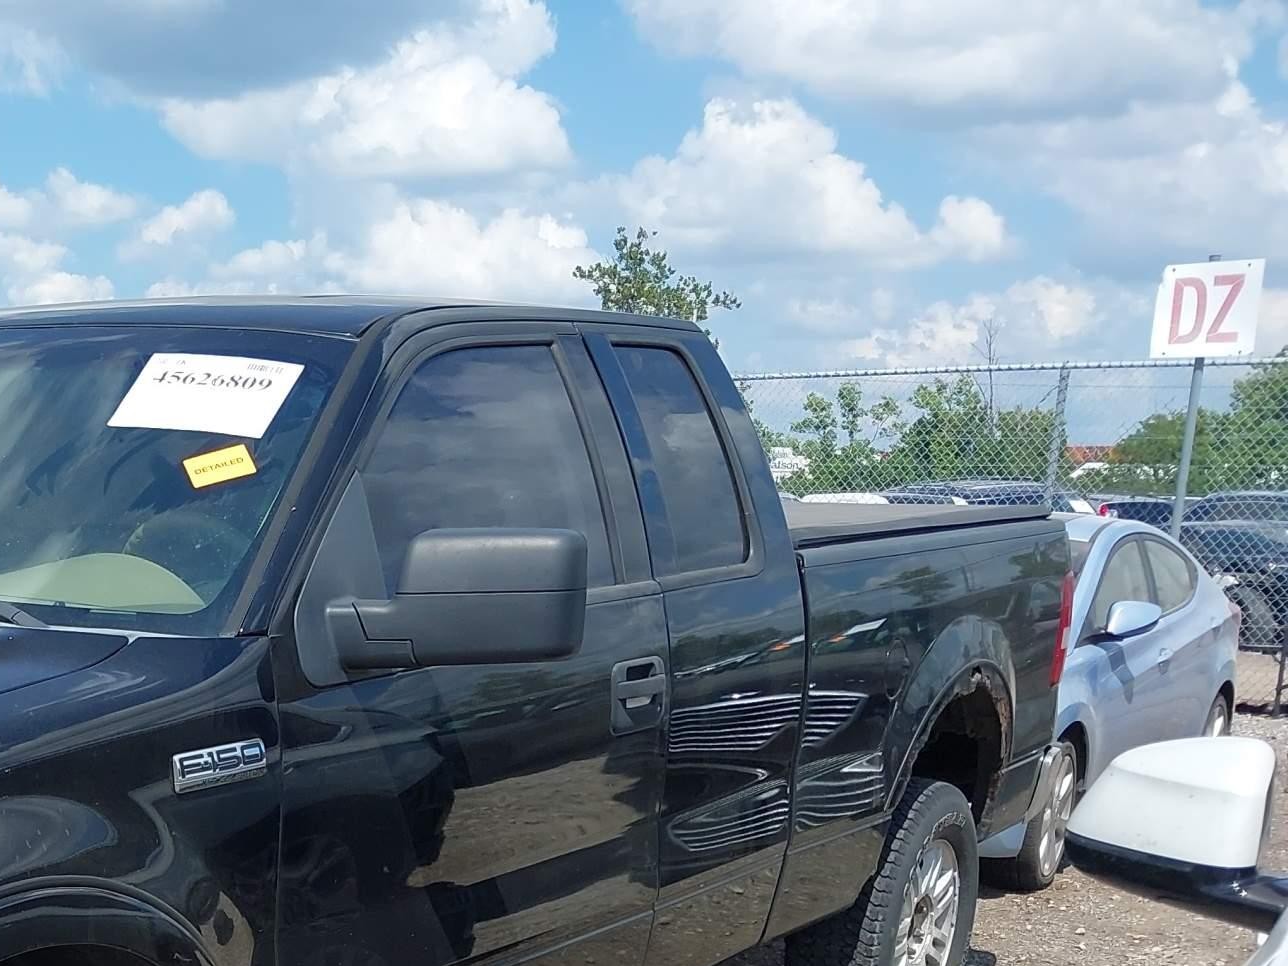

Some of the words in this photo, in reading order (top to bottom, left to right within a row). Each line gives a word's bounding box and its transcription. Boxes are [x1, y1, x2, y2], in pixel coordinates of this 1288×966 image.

[1168, 273, 1246, 344] DZ
[153, 370, 272, 391] 45626809
[194, 457, 244, 475] DETAILED
